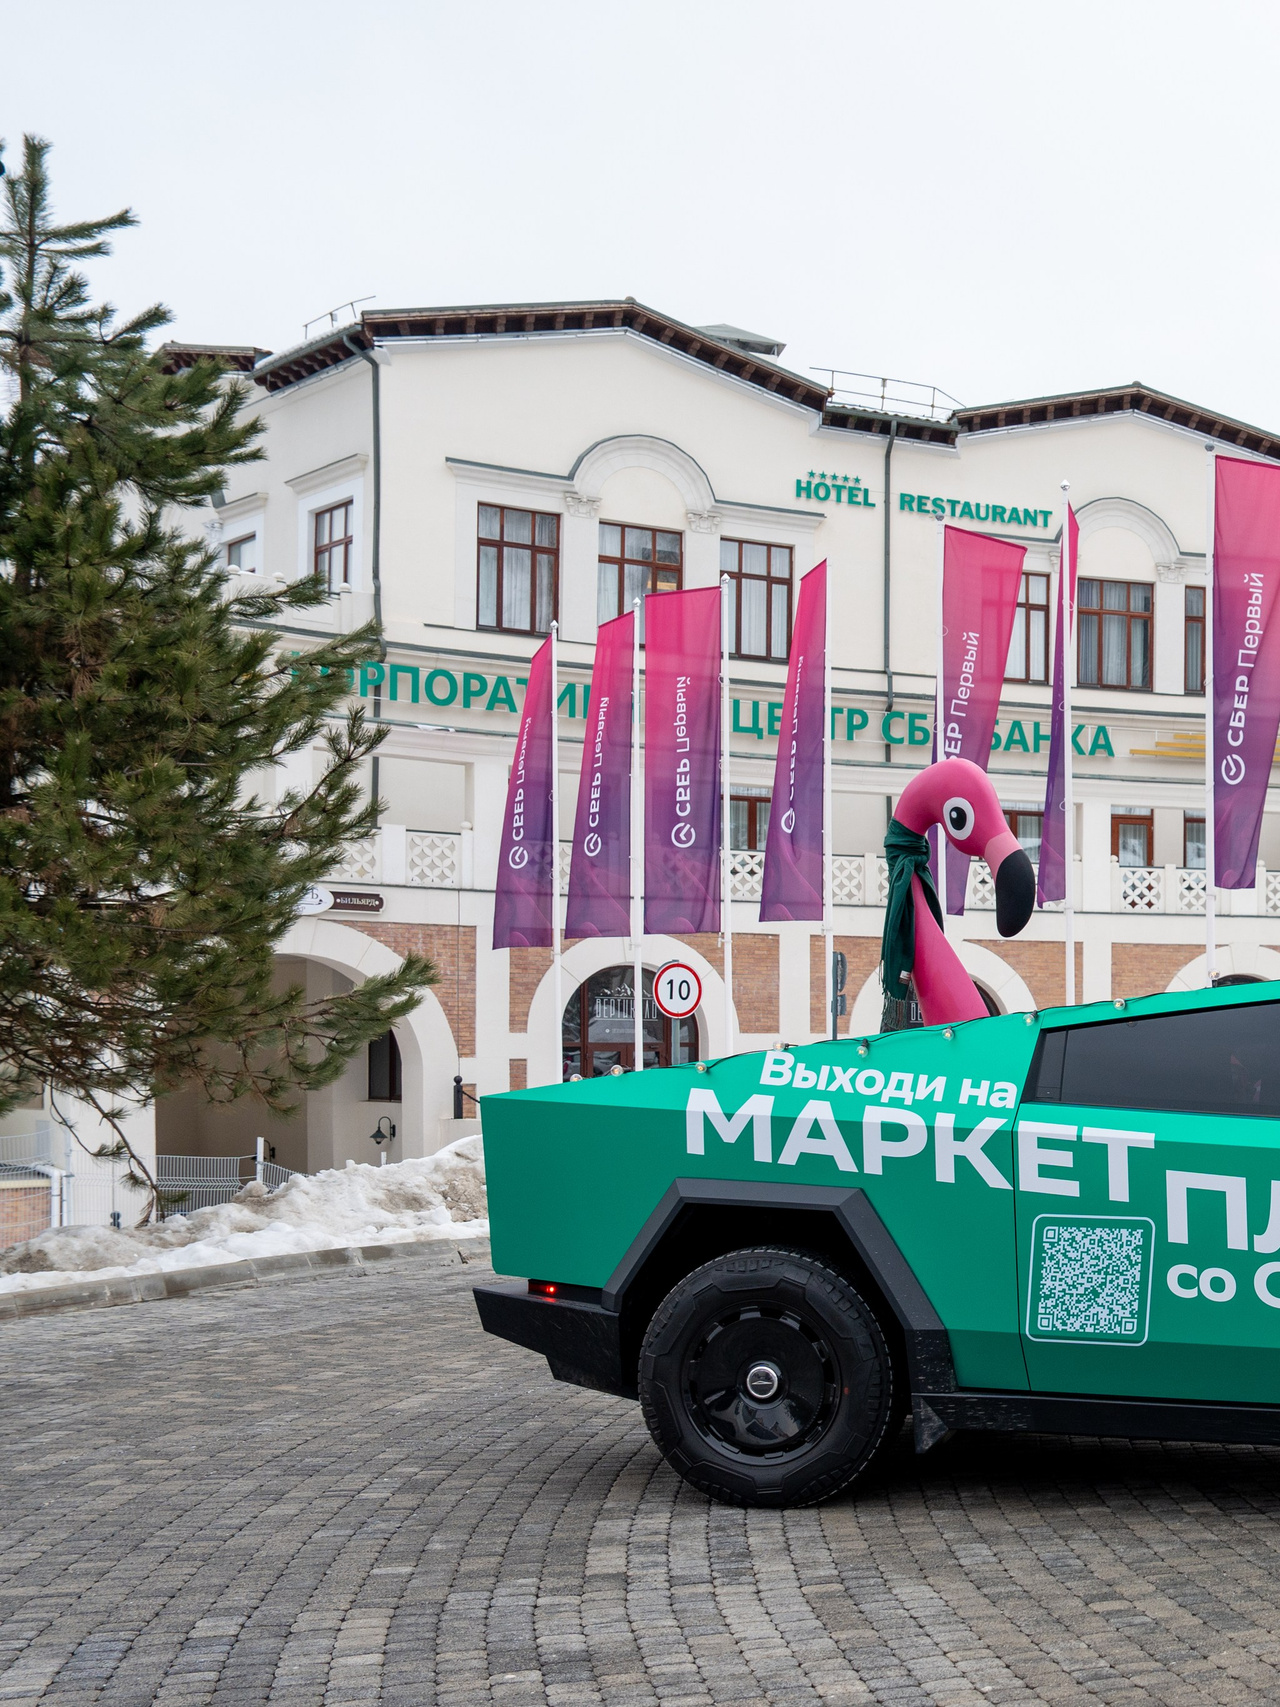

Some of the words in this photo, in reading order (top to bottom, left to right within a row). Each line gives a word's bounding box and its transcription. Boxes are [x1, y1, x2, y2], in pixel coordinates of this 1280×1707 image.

[795, 479, 876, 508] HOTEL
[899, 492, 1053, 528] RESTAURANT
[1237, 572, 1264, 668] Первый
[951, 631, 980, 717] Первый
[732, 698, 869, 741] ЦЕТР
[1227, 674, 1249, 748] СБЕР
[595, 998, 658, 1019] ВЕРТИКЛЬ
[666, 978, 691, 1001] 10
[759, 1050, 947, 1106] Выходи
[959, 1077, 1018, 1110] на
[685, 1087, 1156, 1203] МАРКЕТ
[1166, 1264, 1237, 1303] со
